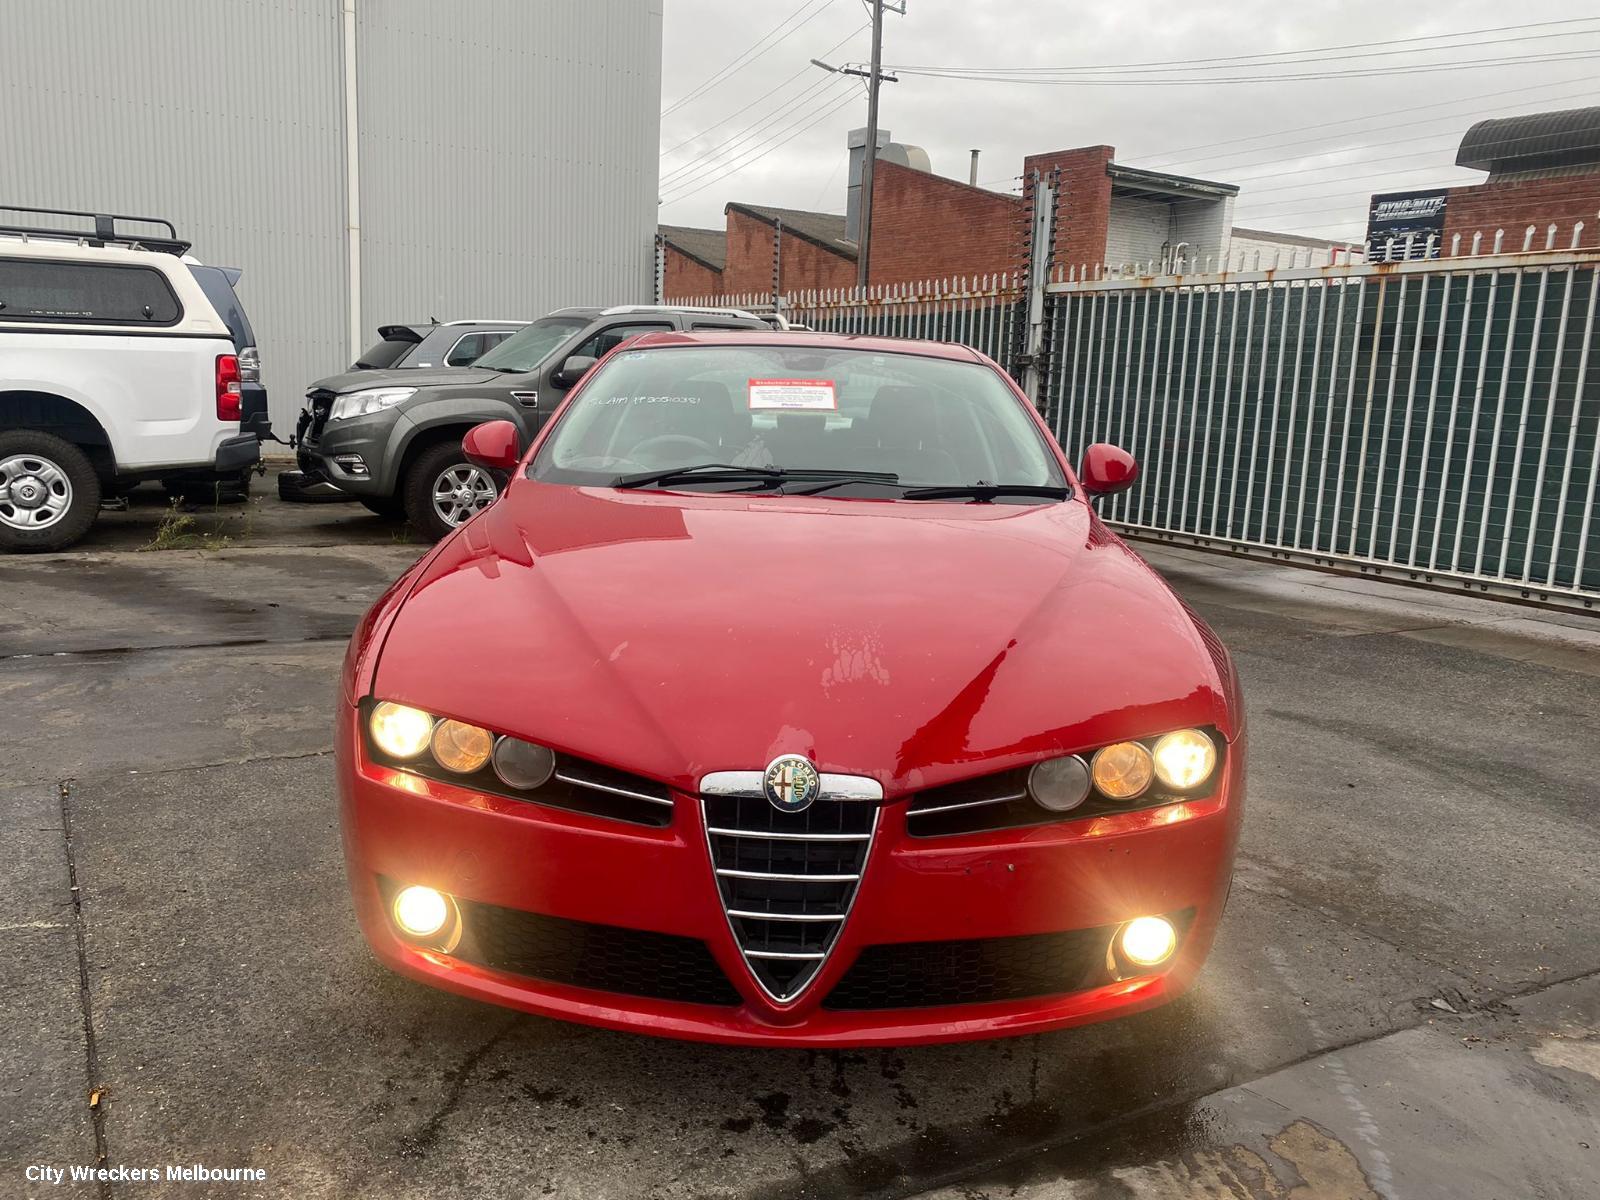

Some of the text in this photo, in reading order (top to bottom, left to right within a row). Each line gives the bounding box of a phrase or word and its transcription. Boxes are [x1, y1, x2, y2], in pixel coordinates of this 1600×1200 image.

[1378, 199, 1442, 213] DYNO-MITE
[1379, 209, 1436, 218] PERFORMANCE
[768, 761, 816, 786] ALFA ROMEO
